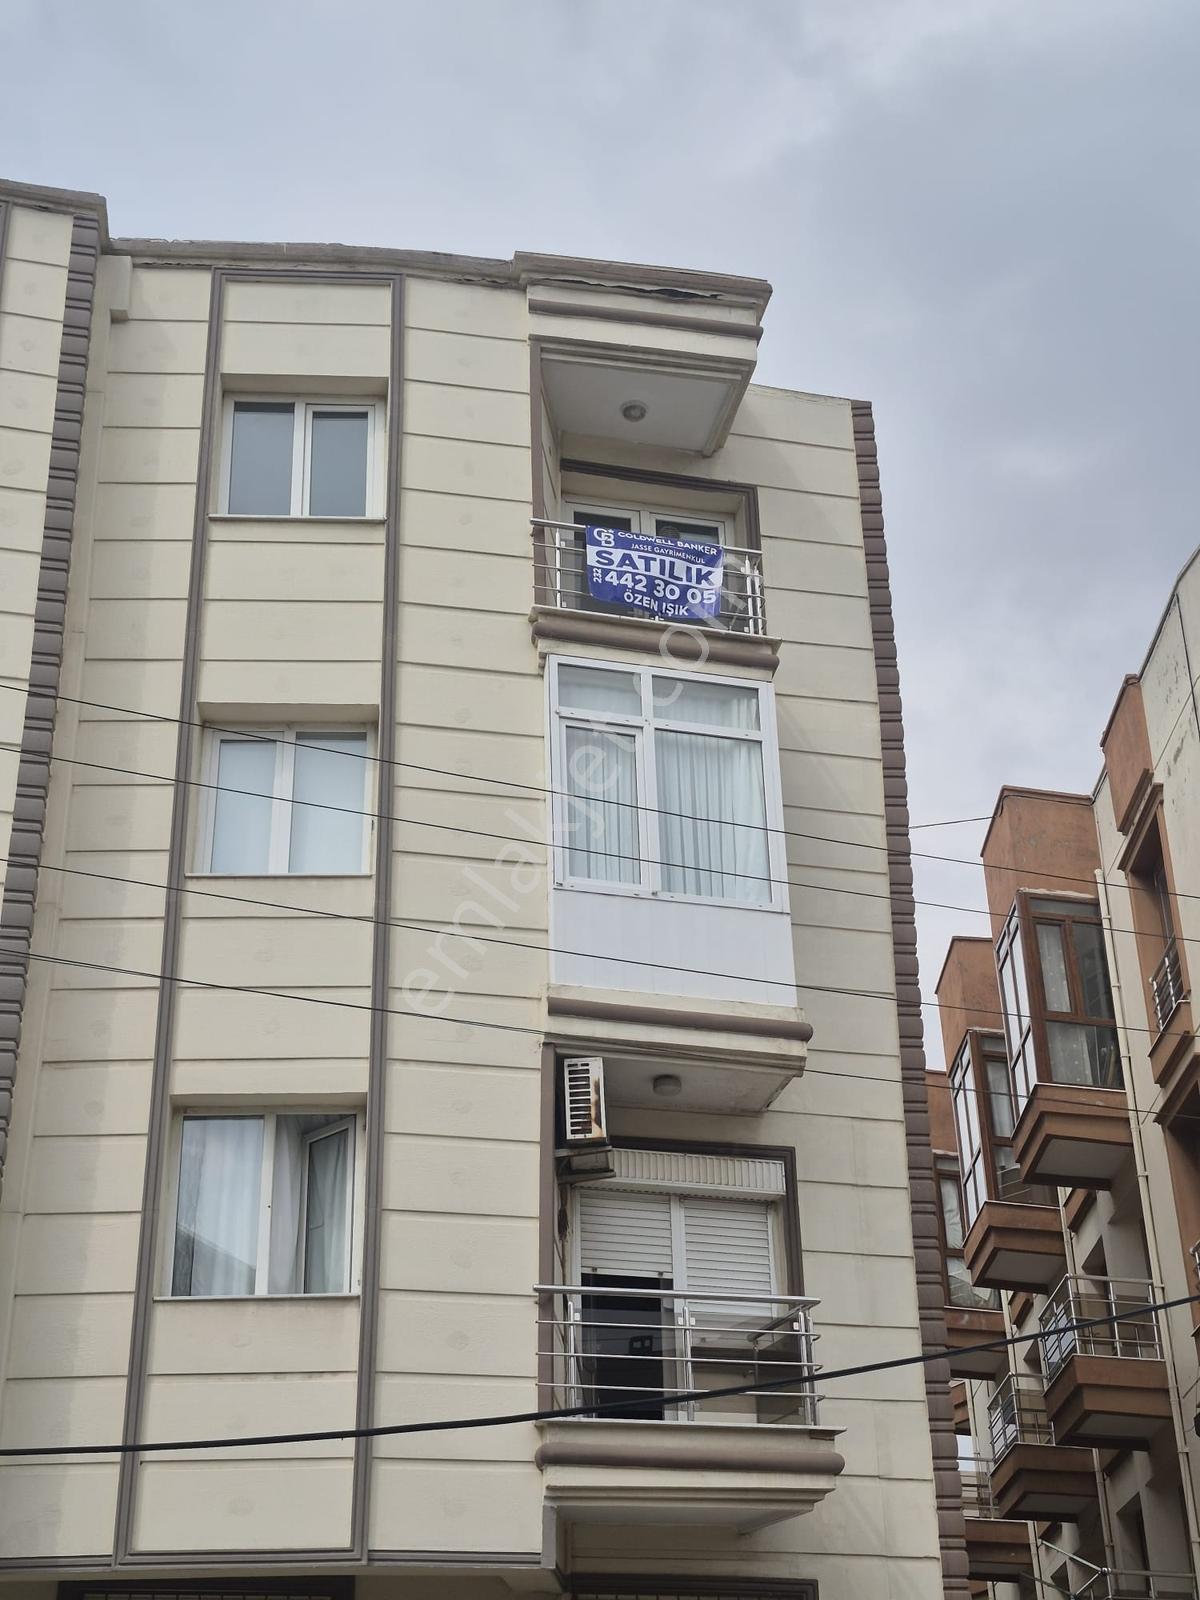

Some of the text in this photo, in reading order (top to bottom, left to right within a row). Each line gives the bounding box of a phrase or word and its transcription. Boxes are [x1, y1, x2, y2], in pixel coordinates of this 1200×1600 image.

[618, 531, 717, 556] COLDWELL BANKER
[631, 543, 652, 552] JASSE
[593, 567, 602, 583] 232
[595, 550, 715, 587] SATILIK
[605, 571, 717, 604] 442 30 05
[623, 589, 689, 617] ÖZEN IŞIK
